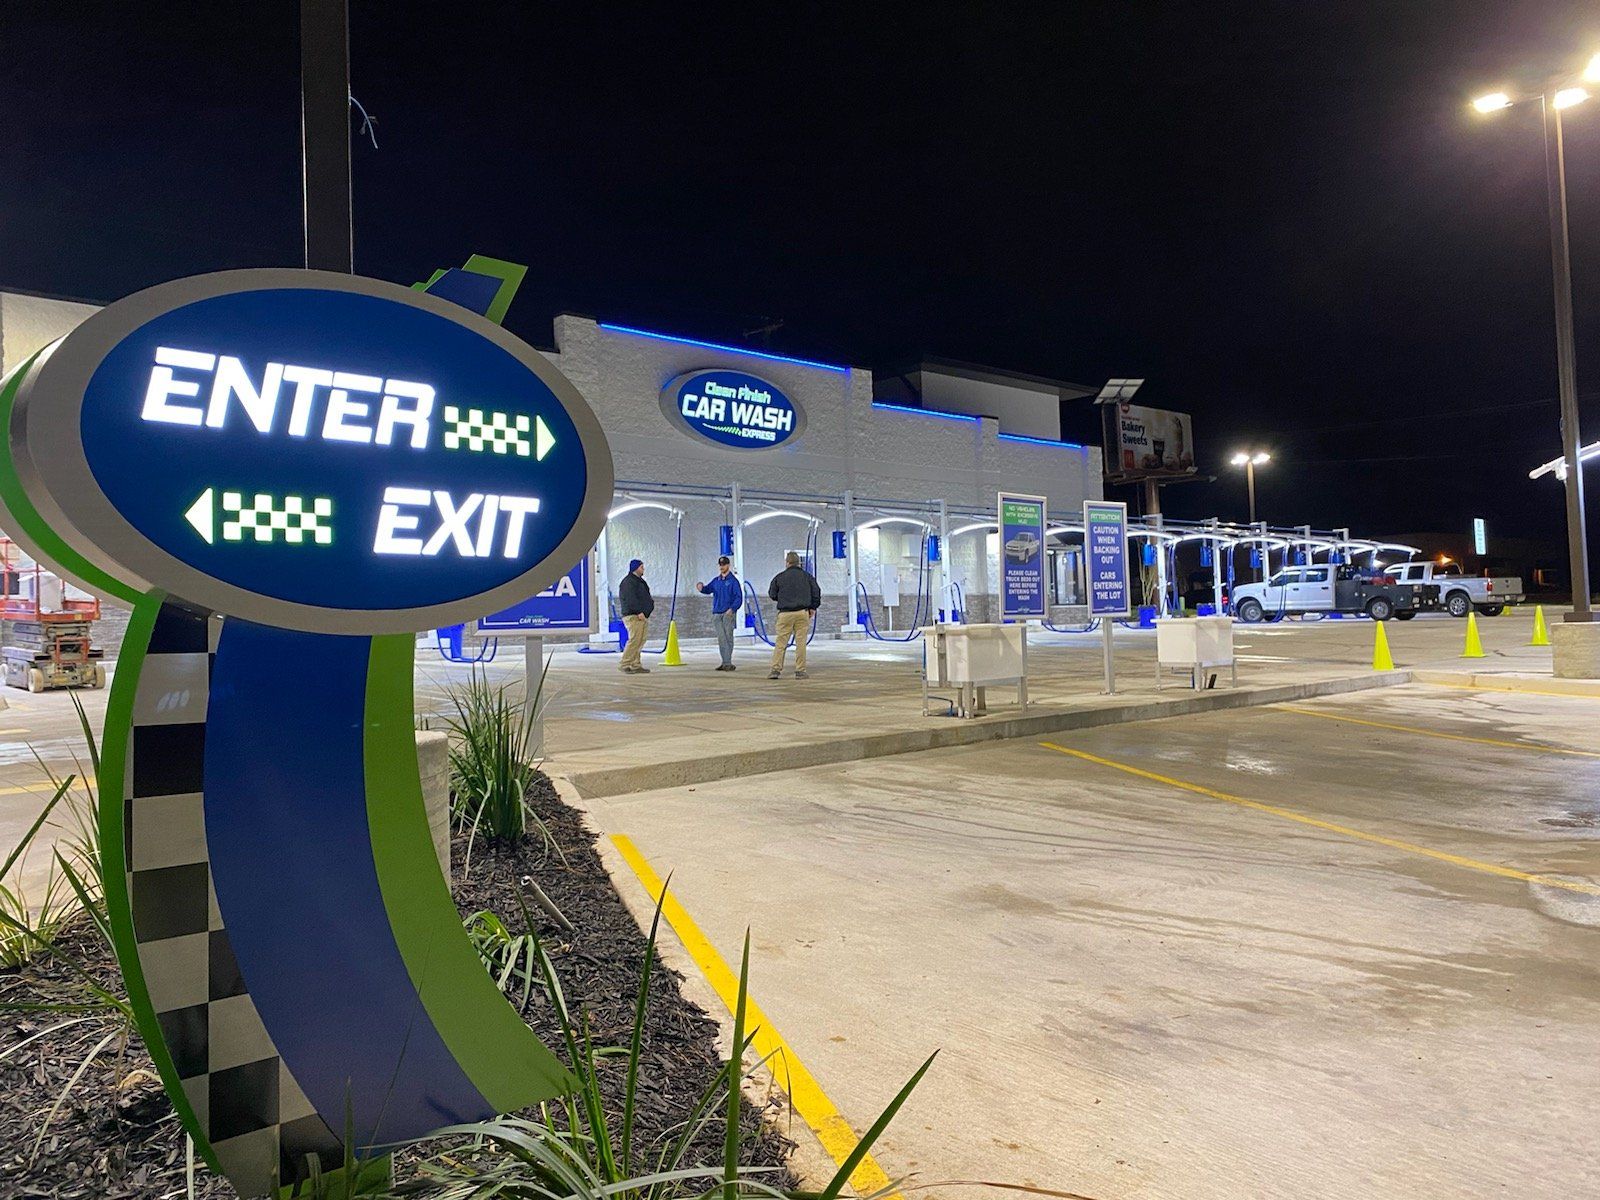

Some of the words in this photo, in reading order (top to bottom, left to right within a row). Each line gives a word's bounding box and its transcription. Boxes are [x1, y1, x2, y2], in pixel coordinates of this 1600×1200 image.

[141, 346, 436, 449] ENTER
[705, 381, 737, 399] Clean
[738, 384, 771, 405] Finish
[682, 394, 726, 421] CAR
[731, 401, 793, 432] WASH
[1121, 421, 1145, 437] Bakery
[741, 427, 777, 442] EXPRESS
[1122, 434, 1148, 445] Sweets
[373, 486, 541, 558] EXIT
[1092, 525, 1119, 534] CAUTION
[1097, 536, 1116, 544] WHEN
[1093, 545, 1120, 554] BACKING
[1101, 555, 1114, 564] OUT
[1100, 571, 1116, 580] CARS
[1093, 581, 1123, 590] ENTERING
[1096, 591, 1109, 600] THE
[1109, 591, 1121, 599] LOT
